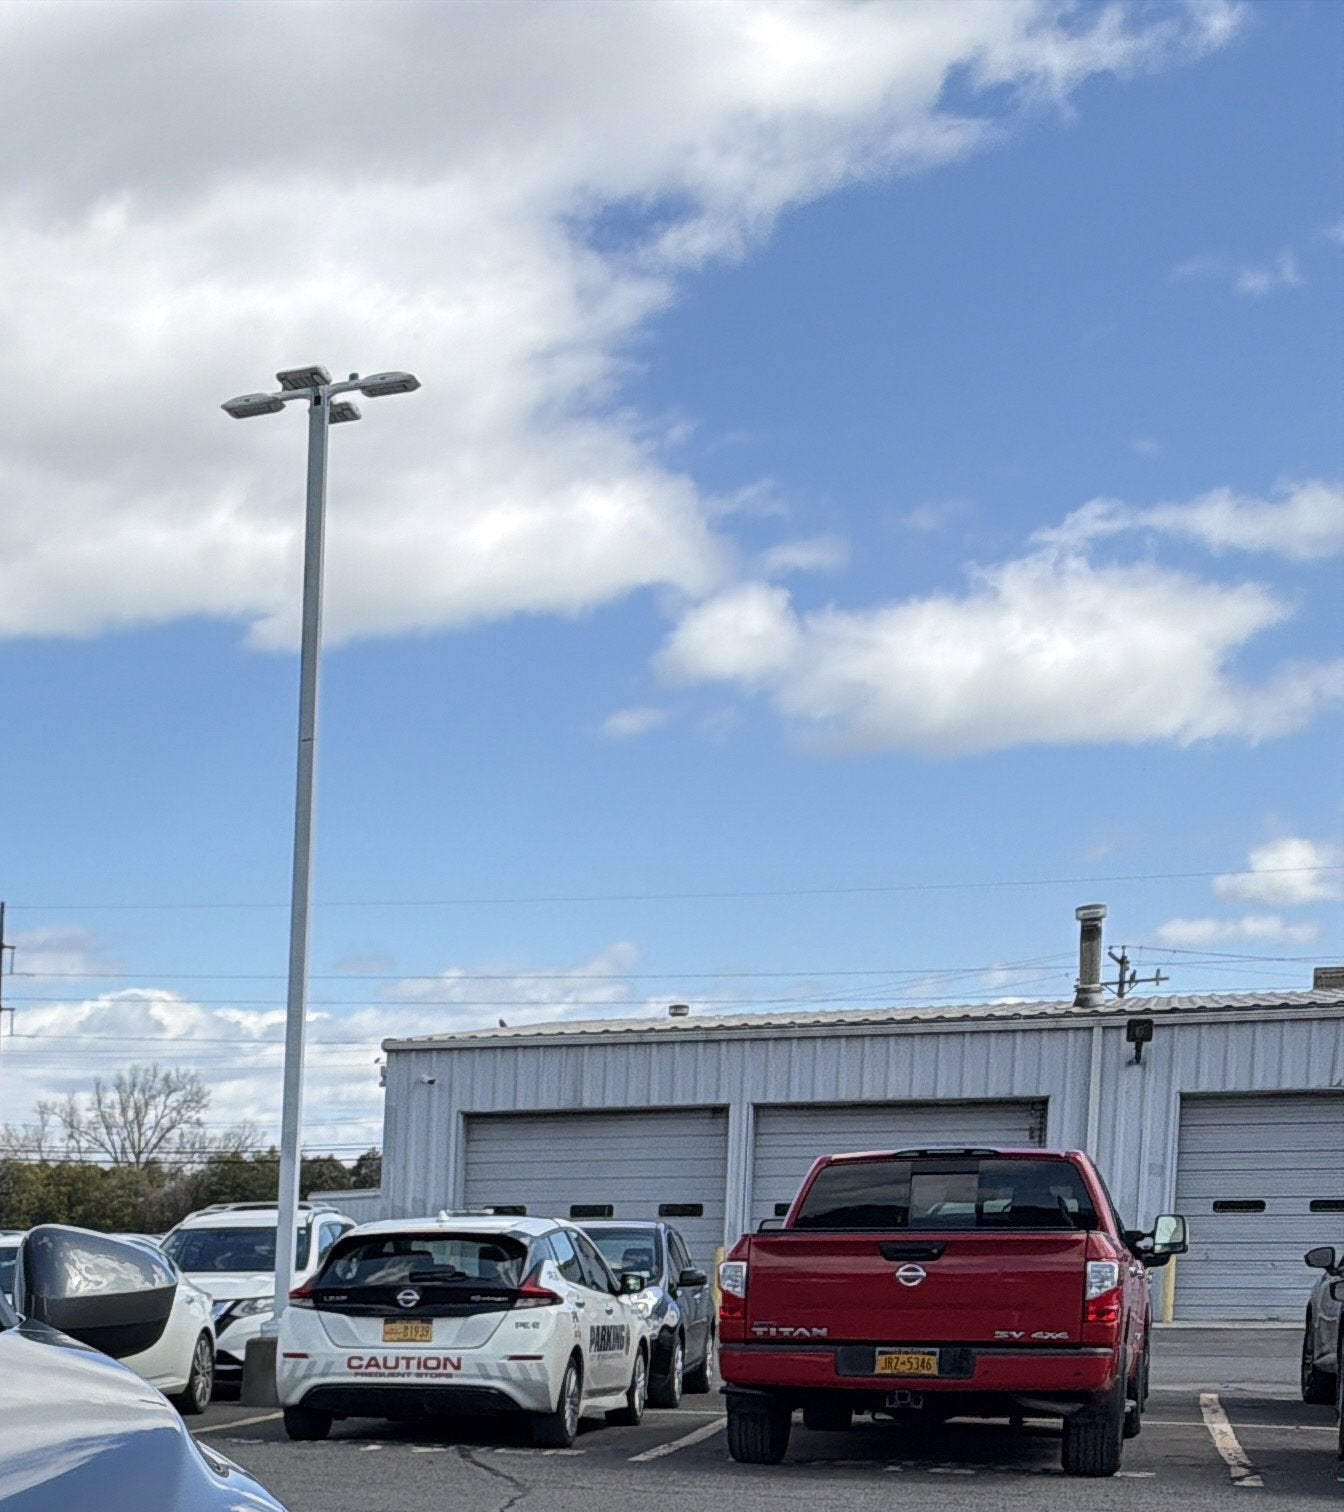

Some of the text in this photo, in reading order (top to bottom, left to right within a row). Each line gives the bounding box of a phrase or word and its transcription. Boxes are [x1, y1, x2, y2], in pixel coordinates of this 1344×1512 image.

[589, 1325, 625, 1353] PARKING
[751, 1327, 828, 1337] TITAN
[347, 1355, 462, 1371] CAUTION
